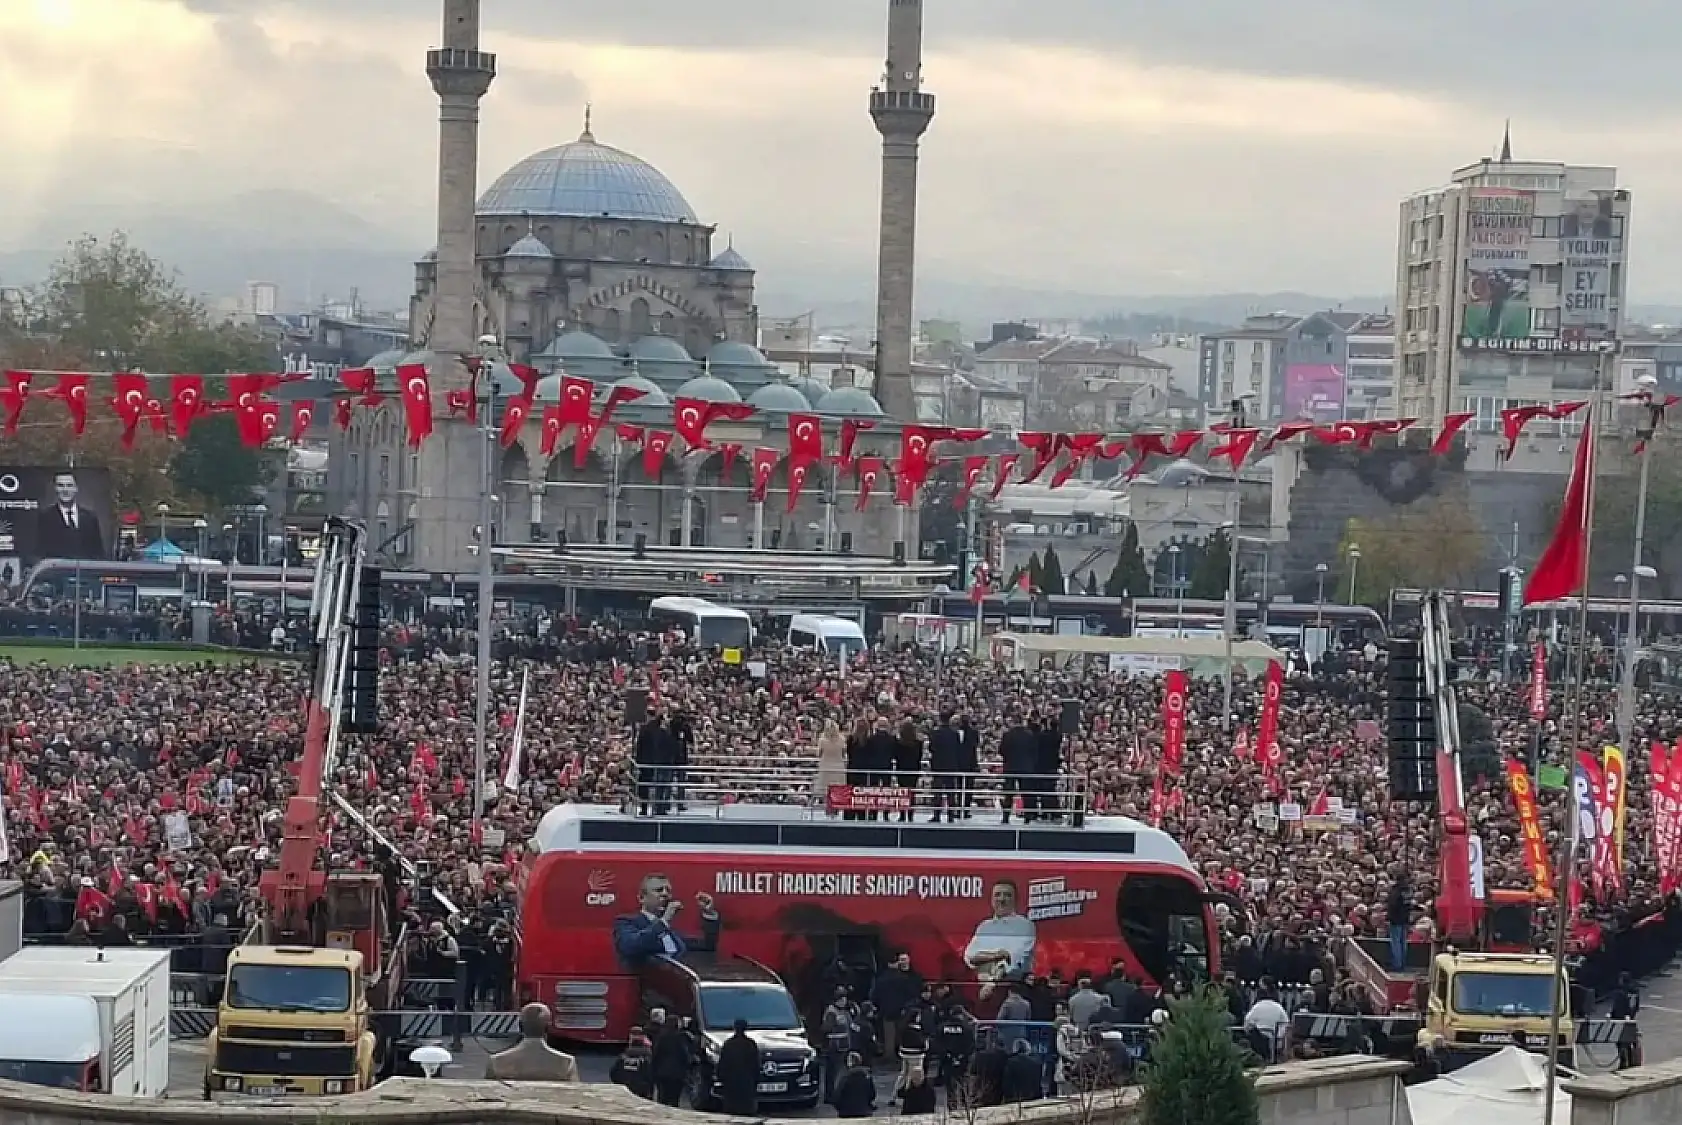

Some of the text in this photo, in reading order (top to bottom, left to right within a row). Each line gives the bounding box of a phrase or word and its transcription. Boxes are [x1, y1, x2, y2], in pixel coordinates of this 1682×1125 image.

[715, 870, 983, 900] MİLLET İRADESİNE SAHİP ÇIKIYOR
